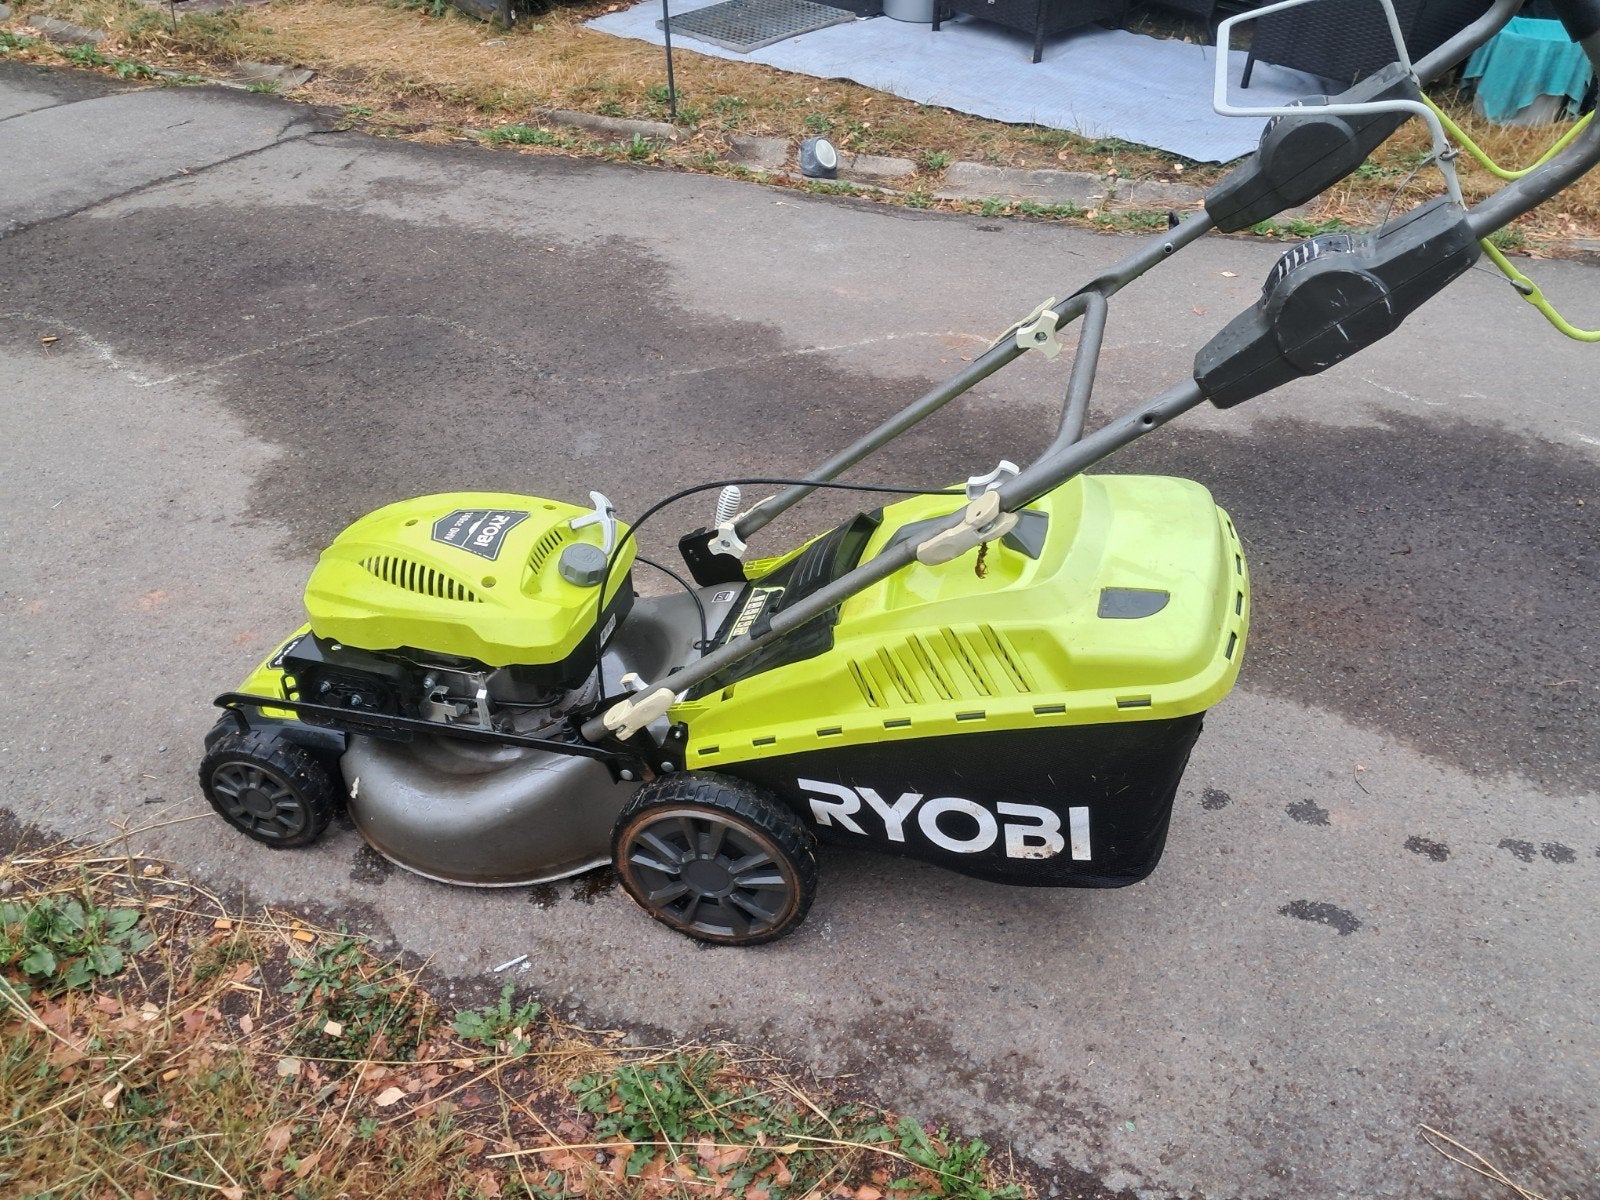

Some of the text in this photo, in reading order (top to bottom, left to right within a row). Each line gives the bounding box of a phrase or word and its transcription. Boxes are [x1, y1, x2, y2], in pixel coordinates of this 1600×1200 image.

[443, 527, 460, 540] OHV
[473, 514, 511, 547] RYOBI
[797, 778, 1092, 861] RYOBI
